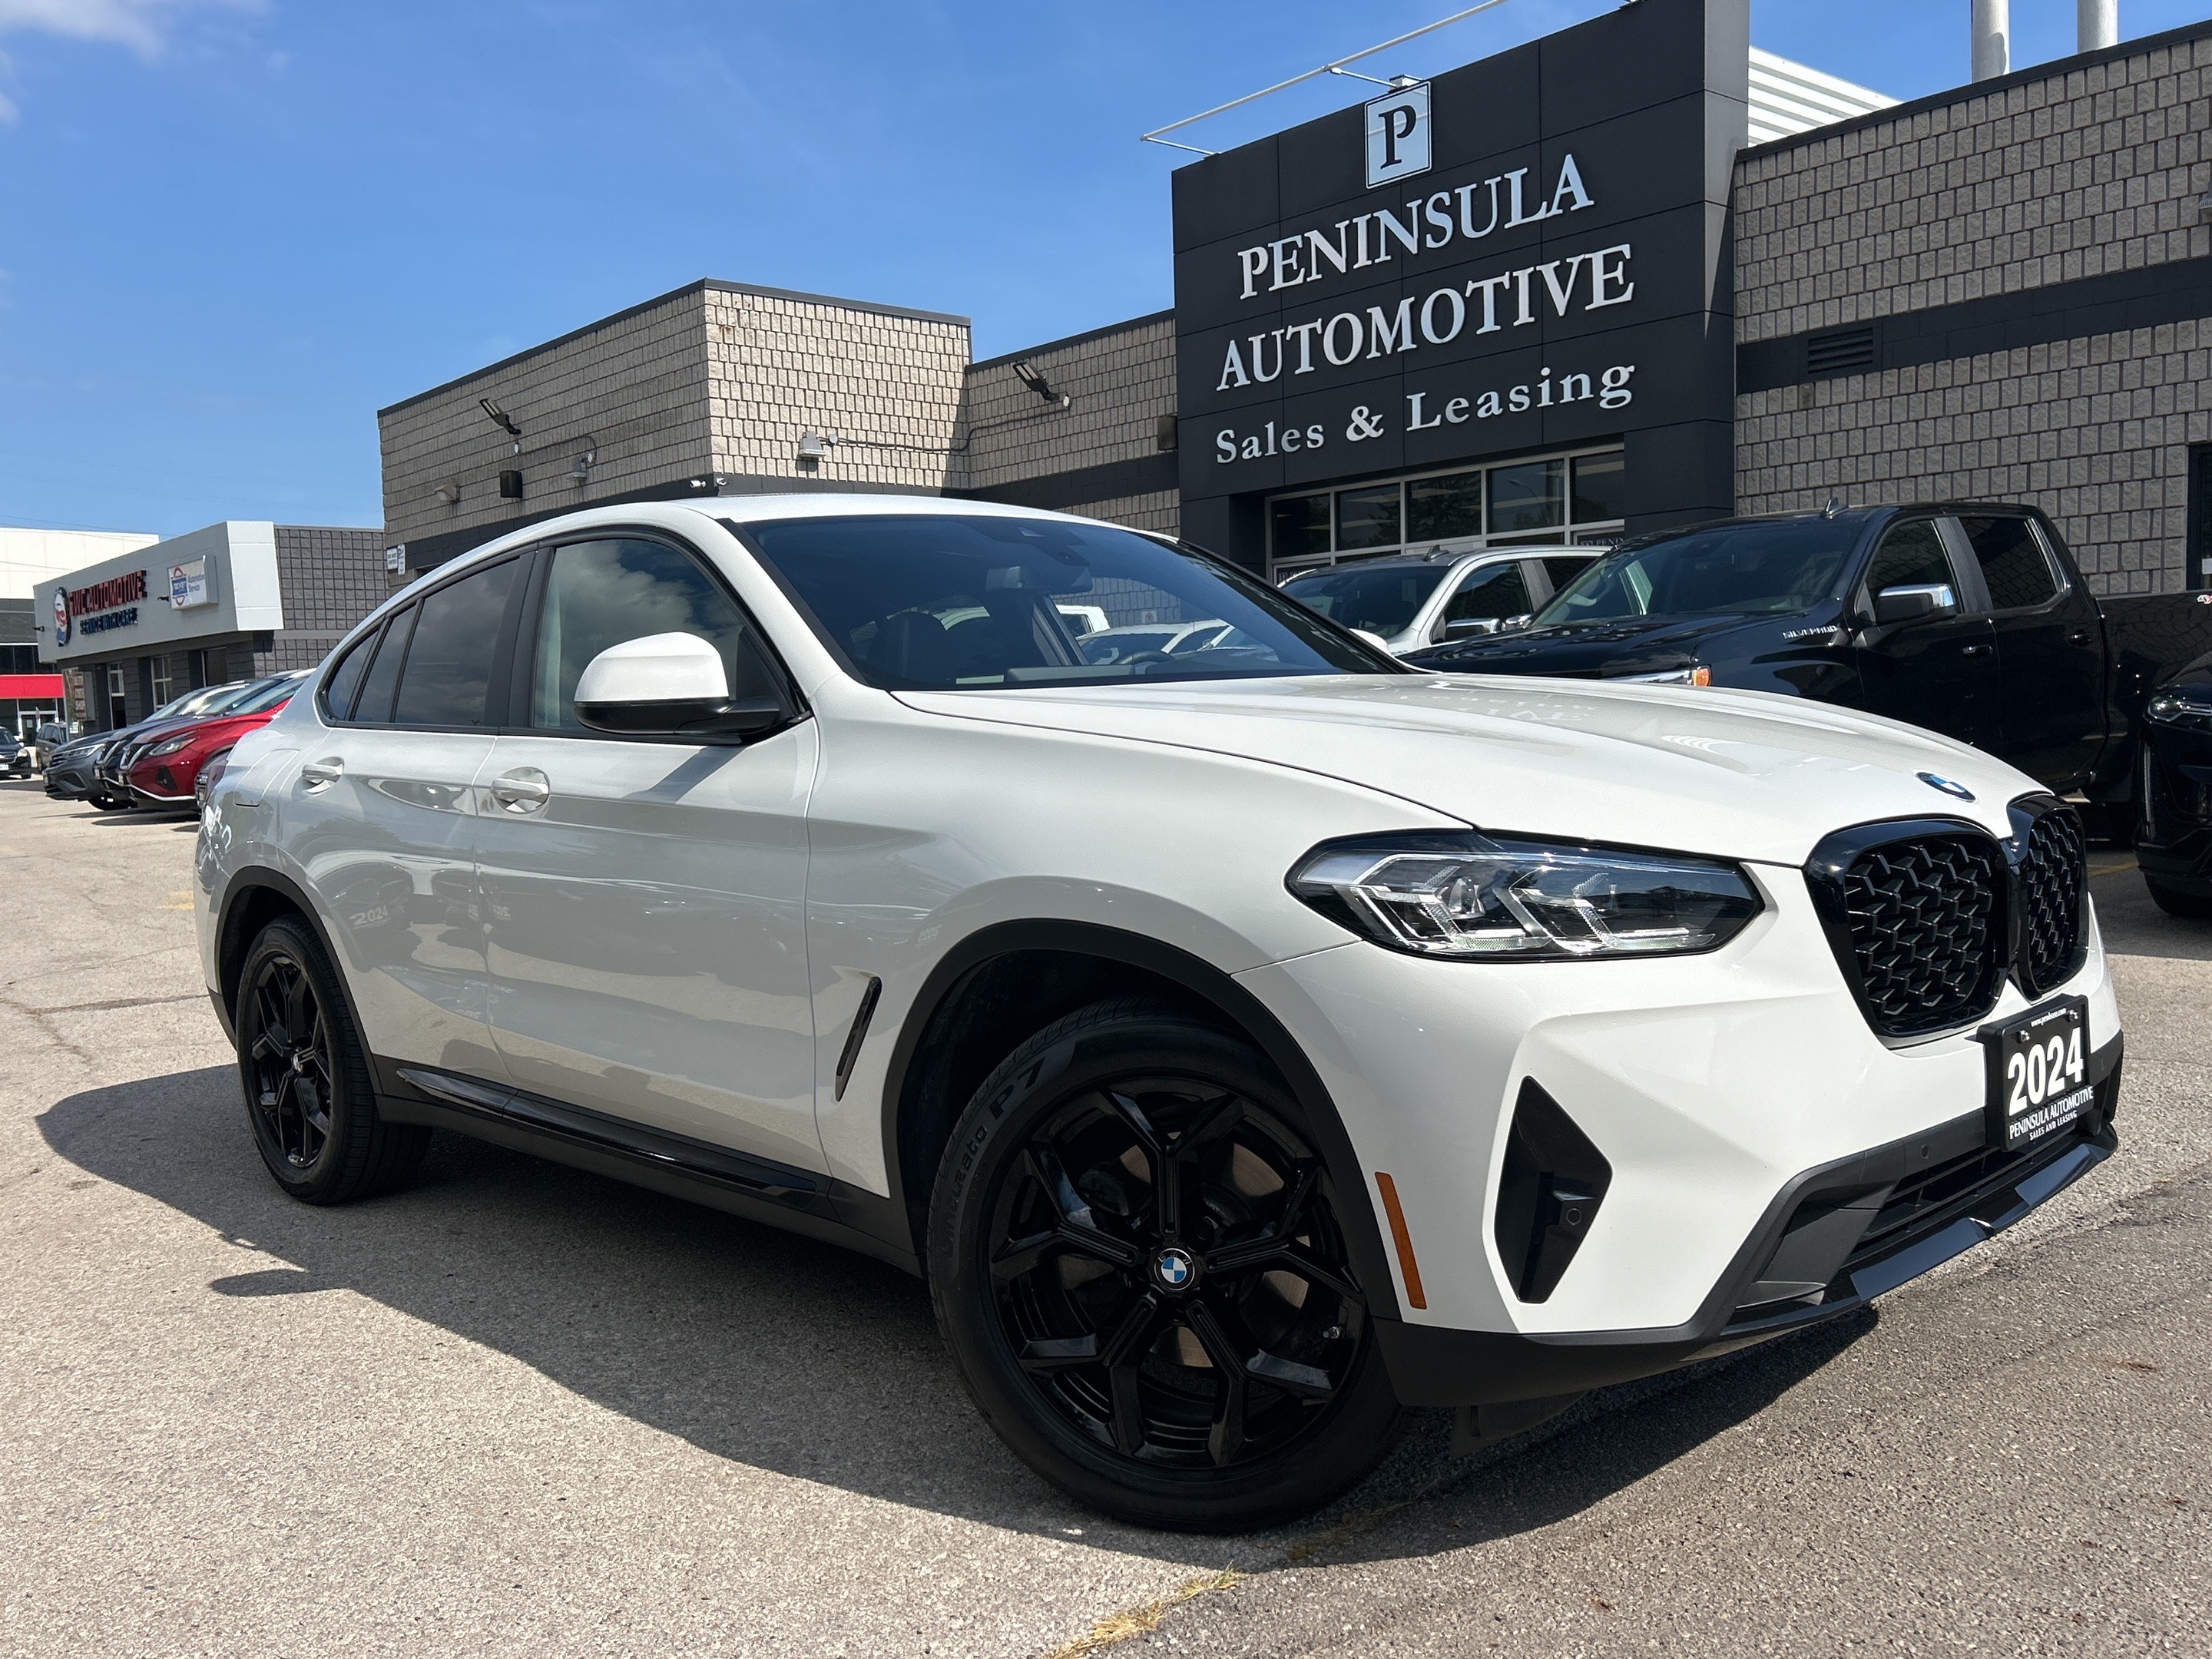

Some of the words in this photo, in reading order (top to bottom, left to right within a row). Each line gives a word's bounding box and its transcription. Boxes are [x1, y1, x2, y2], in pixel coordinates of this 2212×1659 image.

[1379, 104, 1417, 170] P
[1237, 154, 1594, 300] PENINSULA
[1216, 243, 1635, 392] AUTOMOTIVE
[1216, 422, 1325, 464] Sales
[1345, 406, 1385, 442] &
[1406, 364, 1636, 432] Leasing
[88, 570, 147, 613] AUTOMOTIVE
[988, 1056, 1046, 1120] P7
[2007, 1027, 2084, 1116] 2024
[2009, 1106, 2050, 1140] PENINSULA
[2049, 1085, 2094, 1119] AUTOMOTIVE
[2029, 1127, 2045, 1141] SALES
[2045, 1120, 2056, 1132] AND
[2057, 1110, 2078, 1130] LEASING
